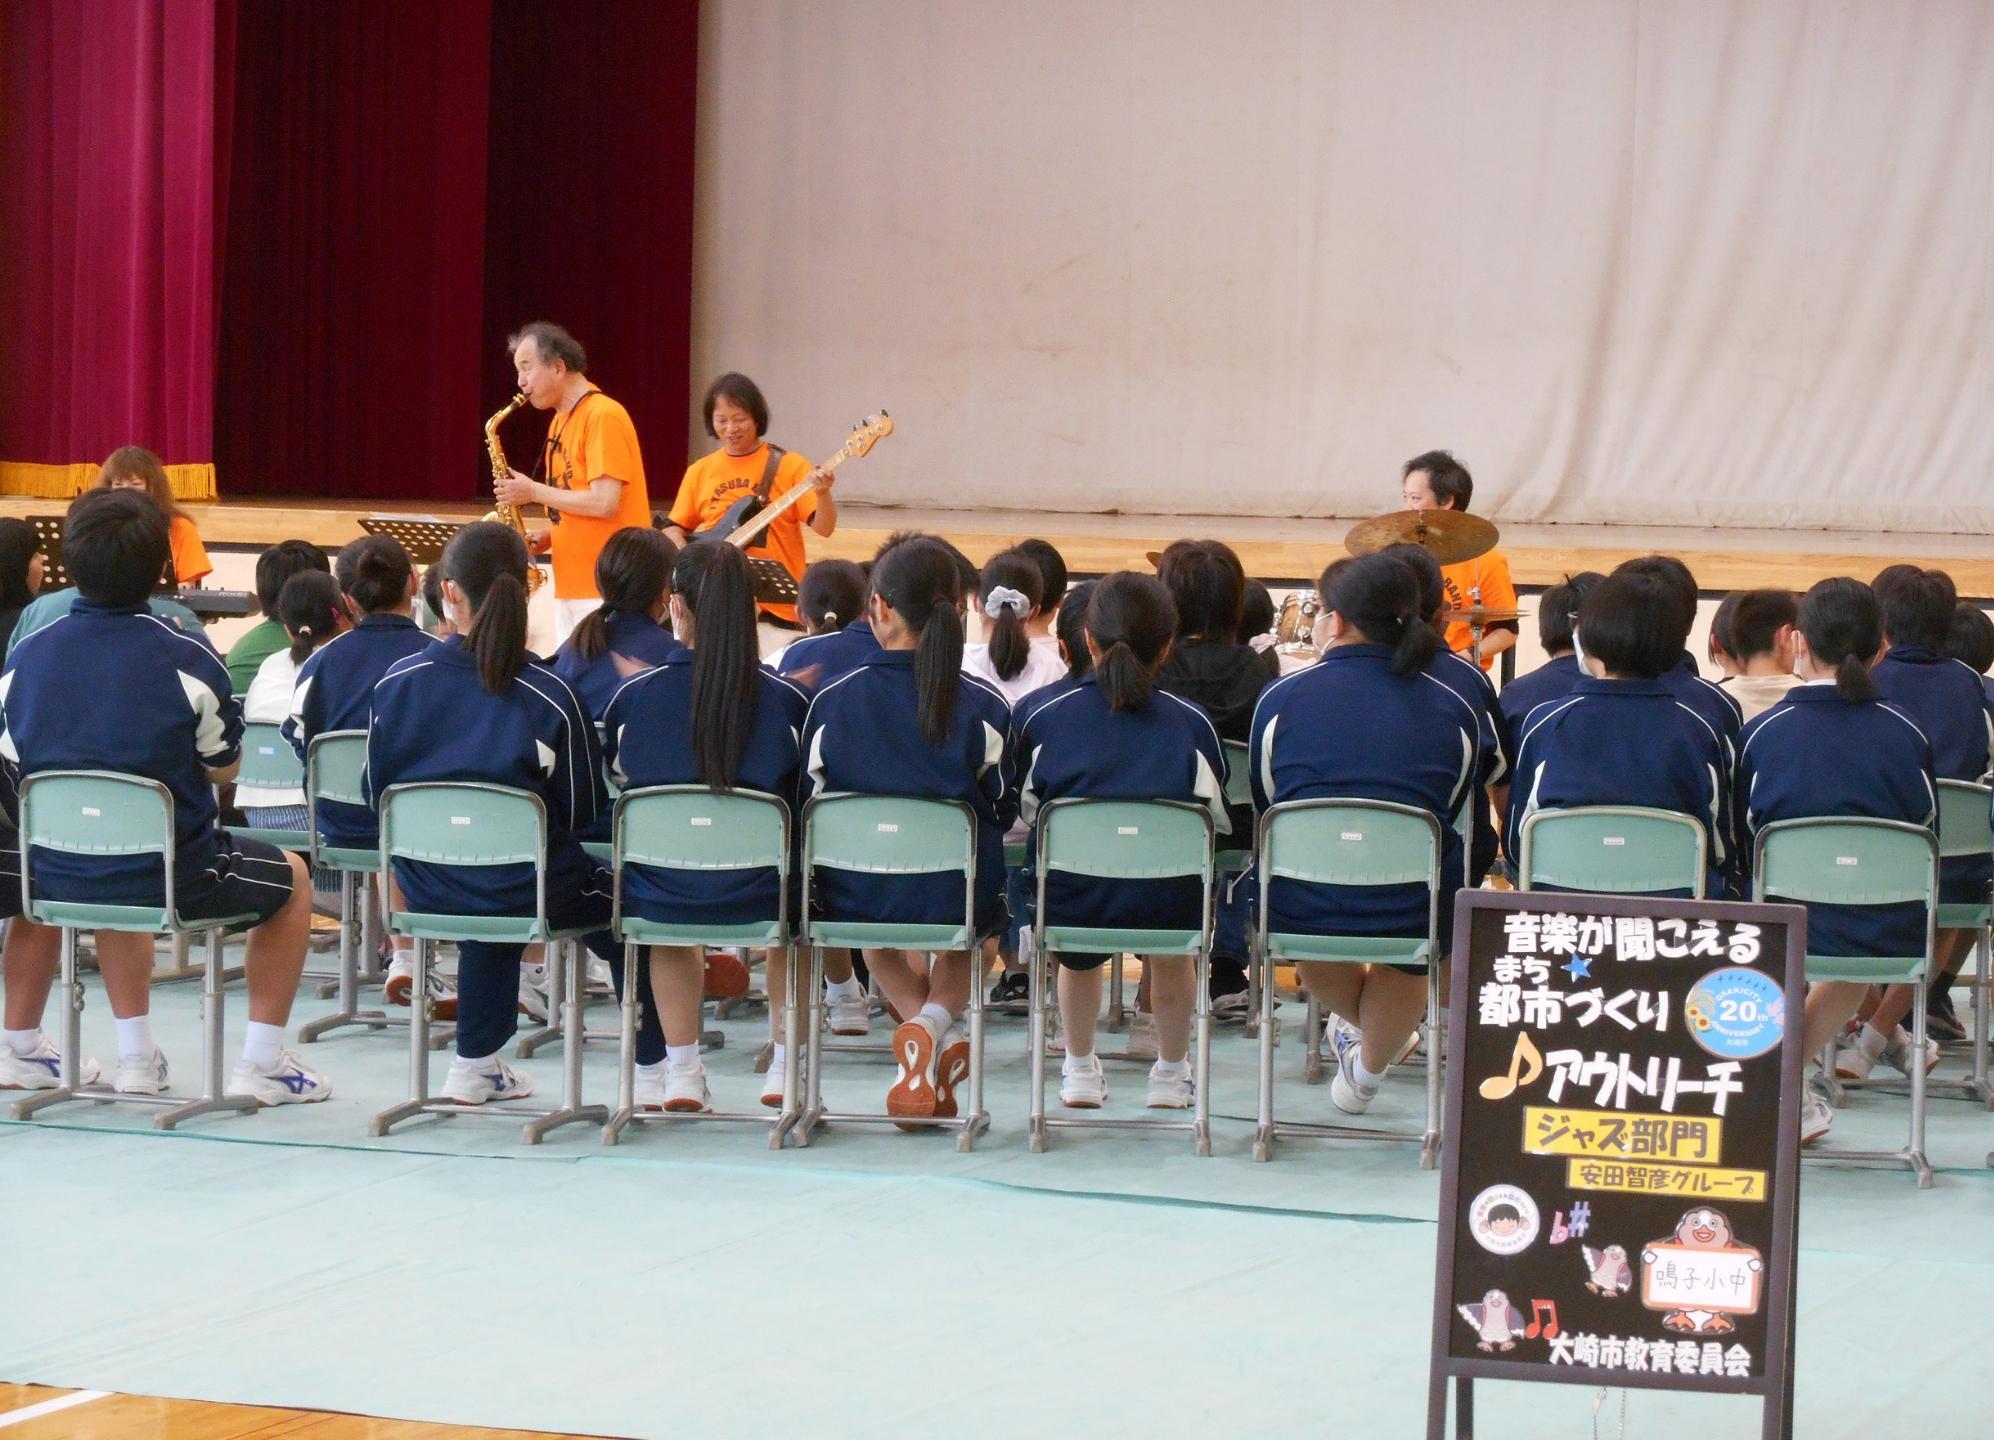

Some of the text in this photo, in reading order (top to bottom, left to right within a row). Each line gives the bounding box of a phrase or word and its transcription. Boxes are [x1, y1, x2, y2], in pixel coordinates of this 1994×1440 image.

[1504, 911, 1761, 964] 音楽が聞こえる
[1493, 954, 1551, 984] まち
[1479, 982, 1669, 1032] 都市づくり
[1546, 1049, 1743, 1117] アウトリーチ
[1537, 1113, 1708, 1158] ジャズ部門
[1580, 1164, 1755, 1195] 安田智彦グループ
[1656, 1260, 1746, 1296] 鳴子小中
[1549, 1331, 1752, 1378] 大崎市教育委員会
